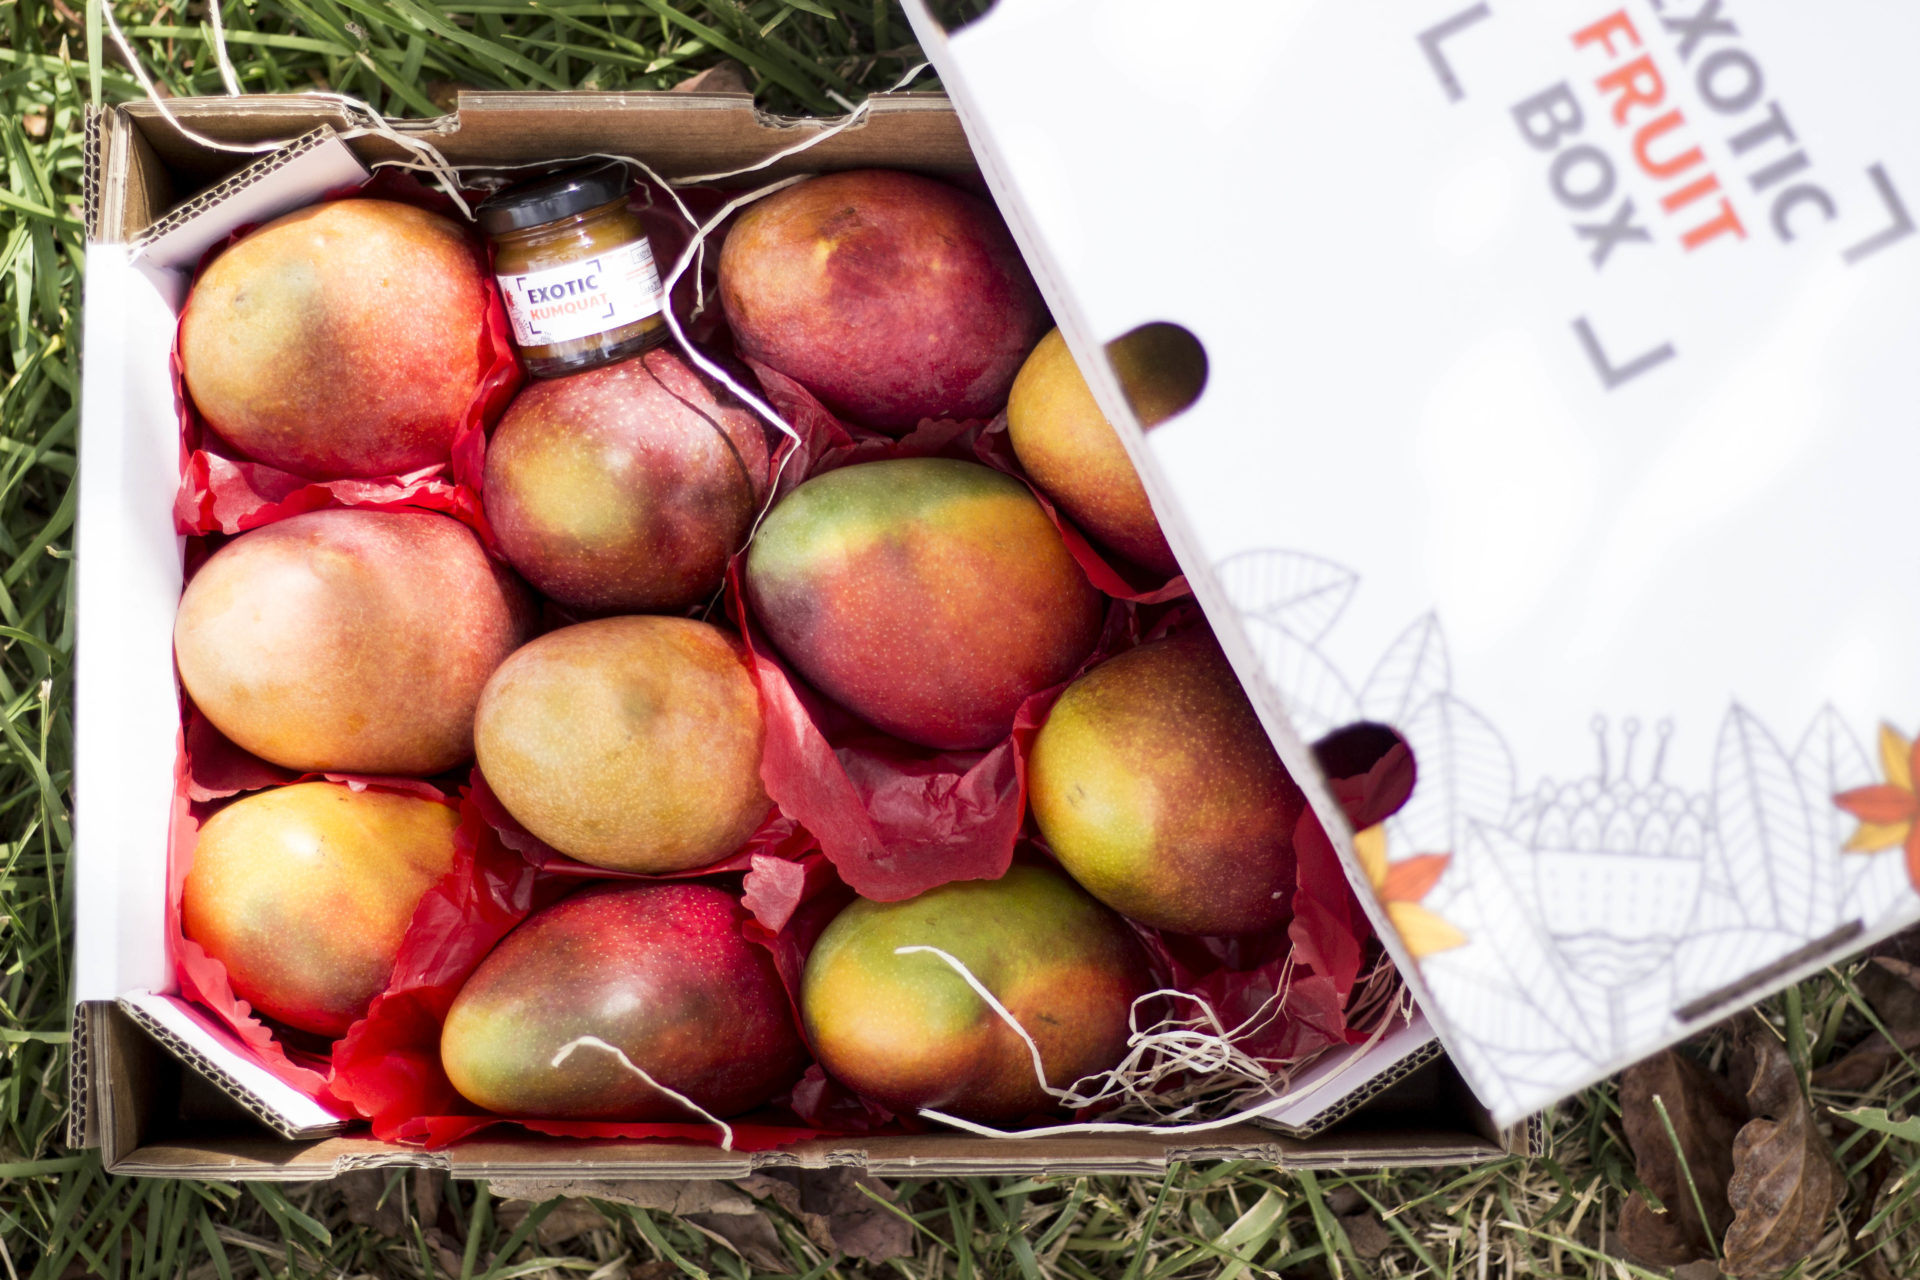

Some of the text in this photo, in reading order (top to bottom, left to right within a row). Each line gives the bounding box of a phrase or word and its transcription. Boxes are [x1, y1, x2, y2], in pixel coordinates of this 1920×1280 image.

[1509, 80, 1654, 272] BOX
[1569, 7, 1748, 253] FRUIT
[1647, 0, 1838, 246] XOTIC
[527, 274, 599, 304] EXOTIC
[529, 292, 608, 321] KUMQUAT
